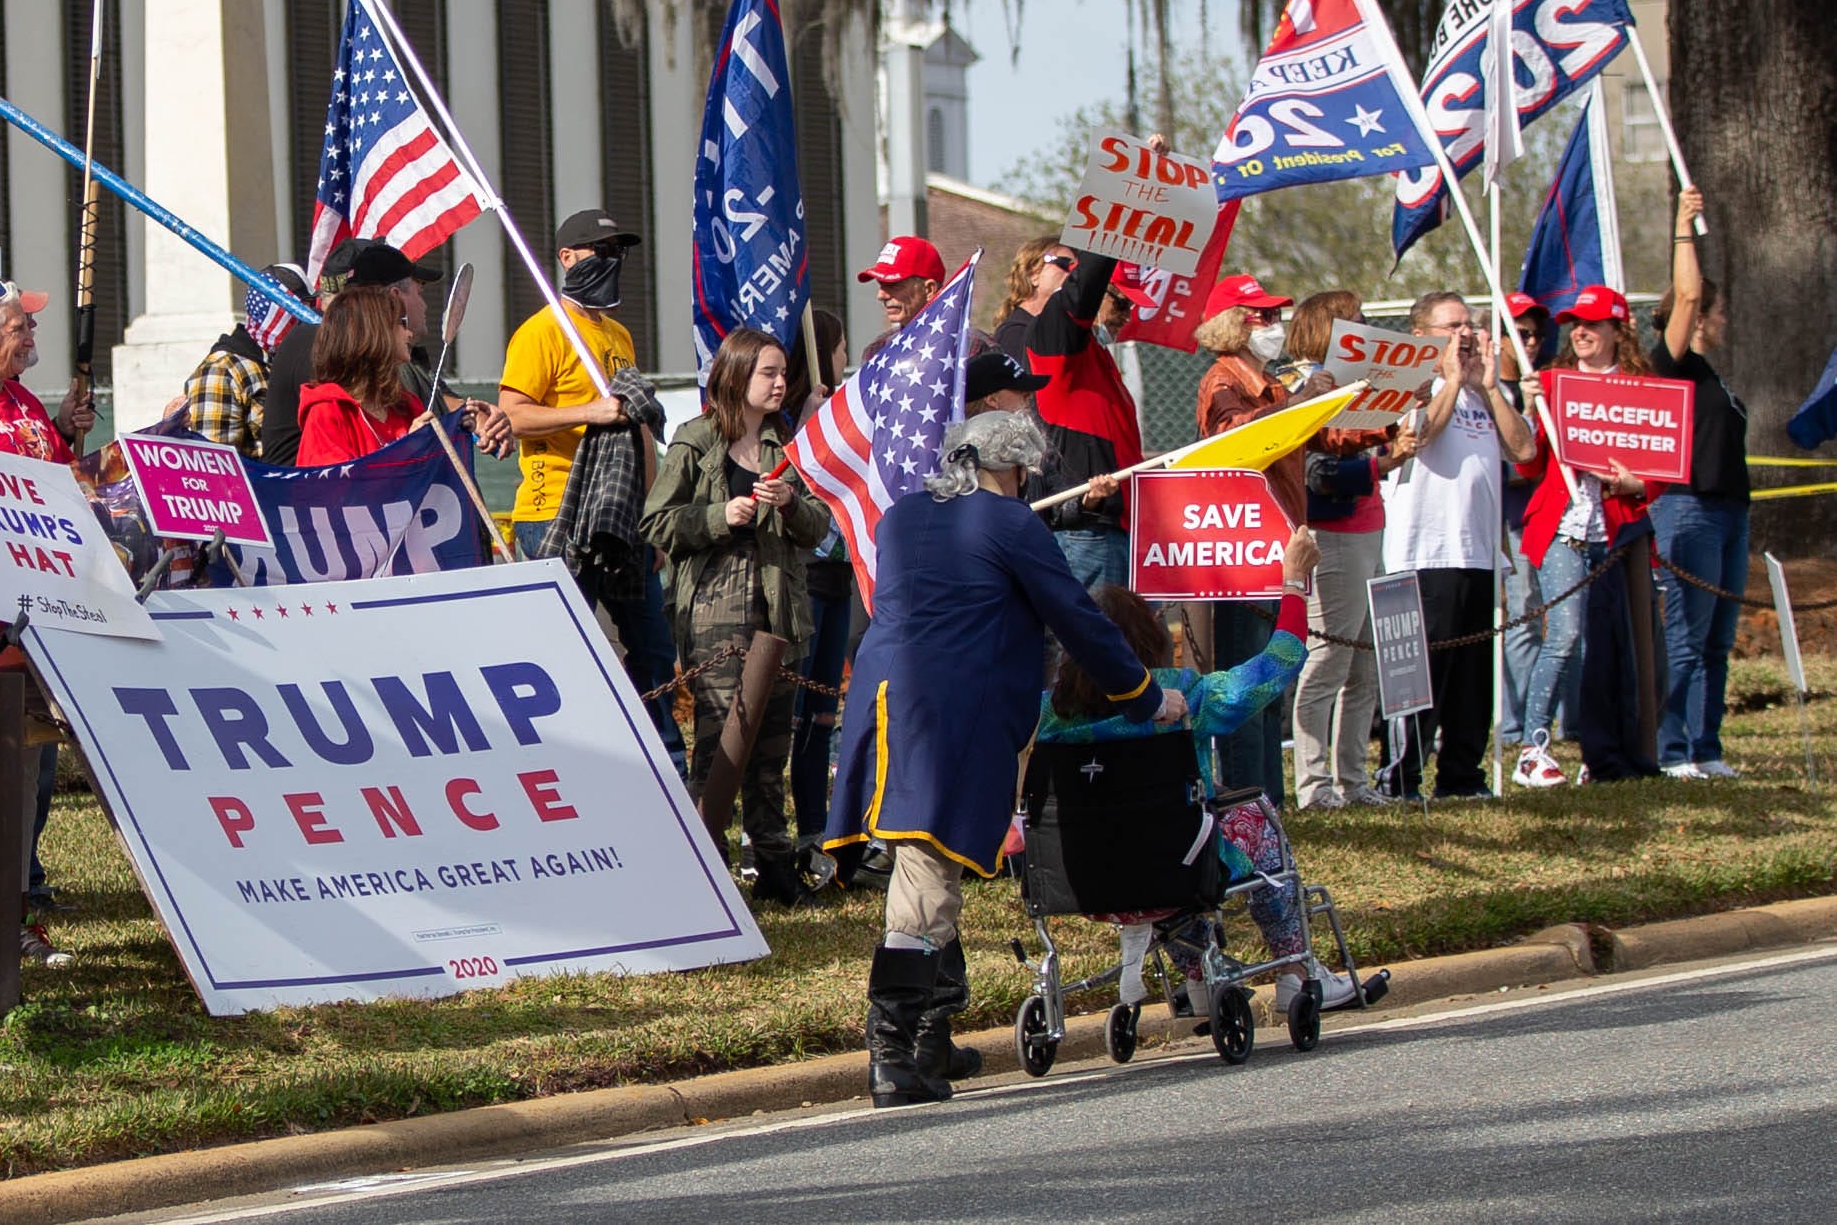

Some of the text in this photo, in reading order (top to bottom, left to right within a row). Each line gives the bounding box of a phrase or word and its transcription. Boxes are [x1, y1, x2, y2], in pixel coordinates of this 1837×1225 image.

[1098, 136, 1209, 190] STOP
[1122, 179, 1171, 203] THE
[1071, 194, 1200, 253] STEAL
[1336, 333, 1439, 369] STOP
[1565, 401, 1678, 429] PEACEFUL
[1567, 425, 1677, 453] PROTESTER
[132, 443, 238, 477] WOMEN
[180, 476, 210, 492] FOR
[161, 494, 243, 525] TRUMP
[1182, 503, 1262, 530] SAVE
[5, 540, 76, 579] HAT
[1142, 540, 1285, 568] AMERICA
[1376, 610, 1420, 643] TRUMP
[1383, 640, 1420, 664] PENCE
[111, 661, 562, 771] TRUMP
[207, 769, 580, 849] PENCE
[236, 846, 624, 904] MAKE AMERICA GREAT AGAIN!
[449, 956, 498, 979] 2020
